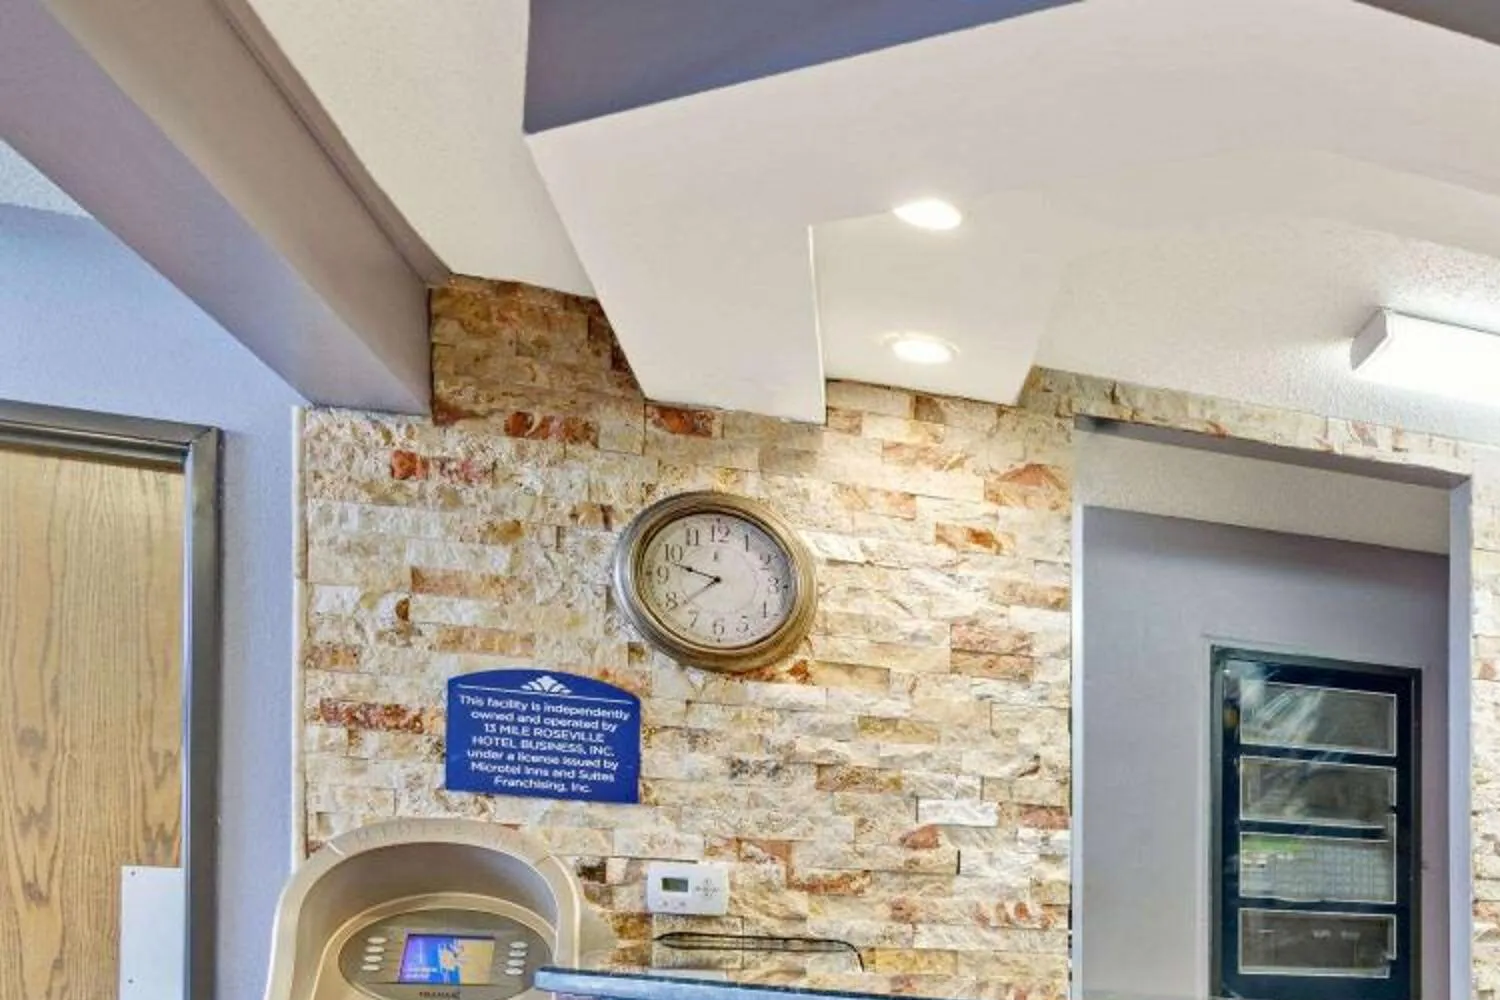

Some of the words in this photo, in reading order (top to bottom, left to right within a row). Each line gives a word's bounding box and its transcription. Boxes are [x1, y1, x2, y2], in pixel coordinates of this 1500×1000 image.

[685, 527, 700, 547] 11
[709, 524, 731, 544] 12
[743, 532, 750, 553] 1
[664, 543, 684, 563] 10
[656, 565, 670, 585] 9
[664, 591, 679, 611] 8
[687, 609, 699, 629] 7
[712, 617, 726, 636] 6
[460, 695, 484, 707] This
[487, 697, 528, 711] facility
[531, 701, 541, 711] is
[543, 702, 631, 721] independently
[471, 711, 515, 721] owned
[517, 714, 541, 725] and
[543, 717, 599, 730] operated
[601, 721, 618, 733] by
[500, 725, 530, 737] MILE
[533, 727, 605, 743] ROSEVILLE
[472, 736, 517, 749] HOTEL
[589, 746, 615, 757] INC.
[467, 749, 504, 761] under
[507, 754, 515, 762] a
[517, 752, 560, 765] license
[563, 756, 600, 768] issued
[603, 759, 619, 772] by
[471, 762, 521, 775] Microtel
[523, 765, 549, 777] Inns
[552, 769, 575, 779] and
[578, 769, 615, 783] Suites
[571, 782, 592, 793] Inc.
